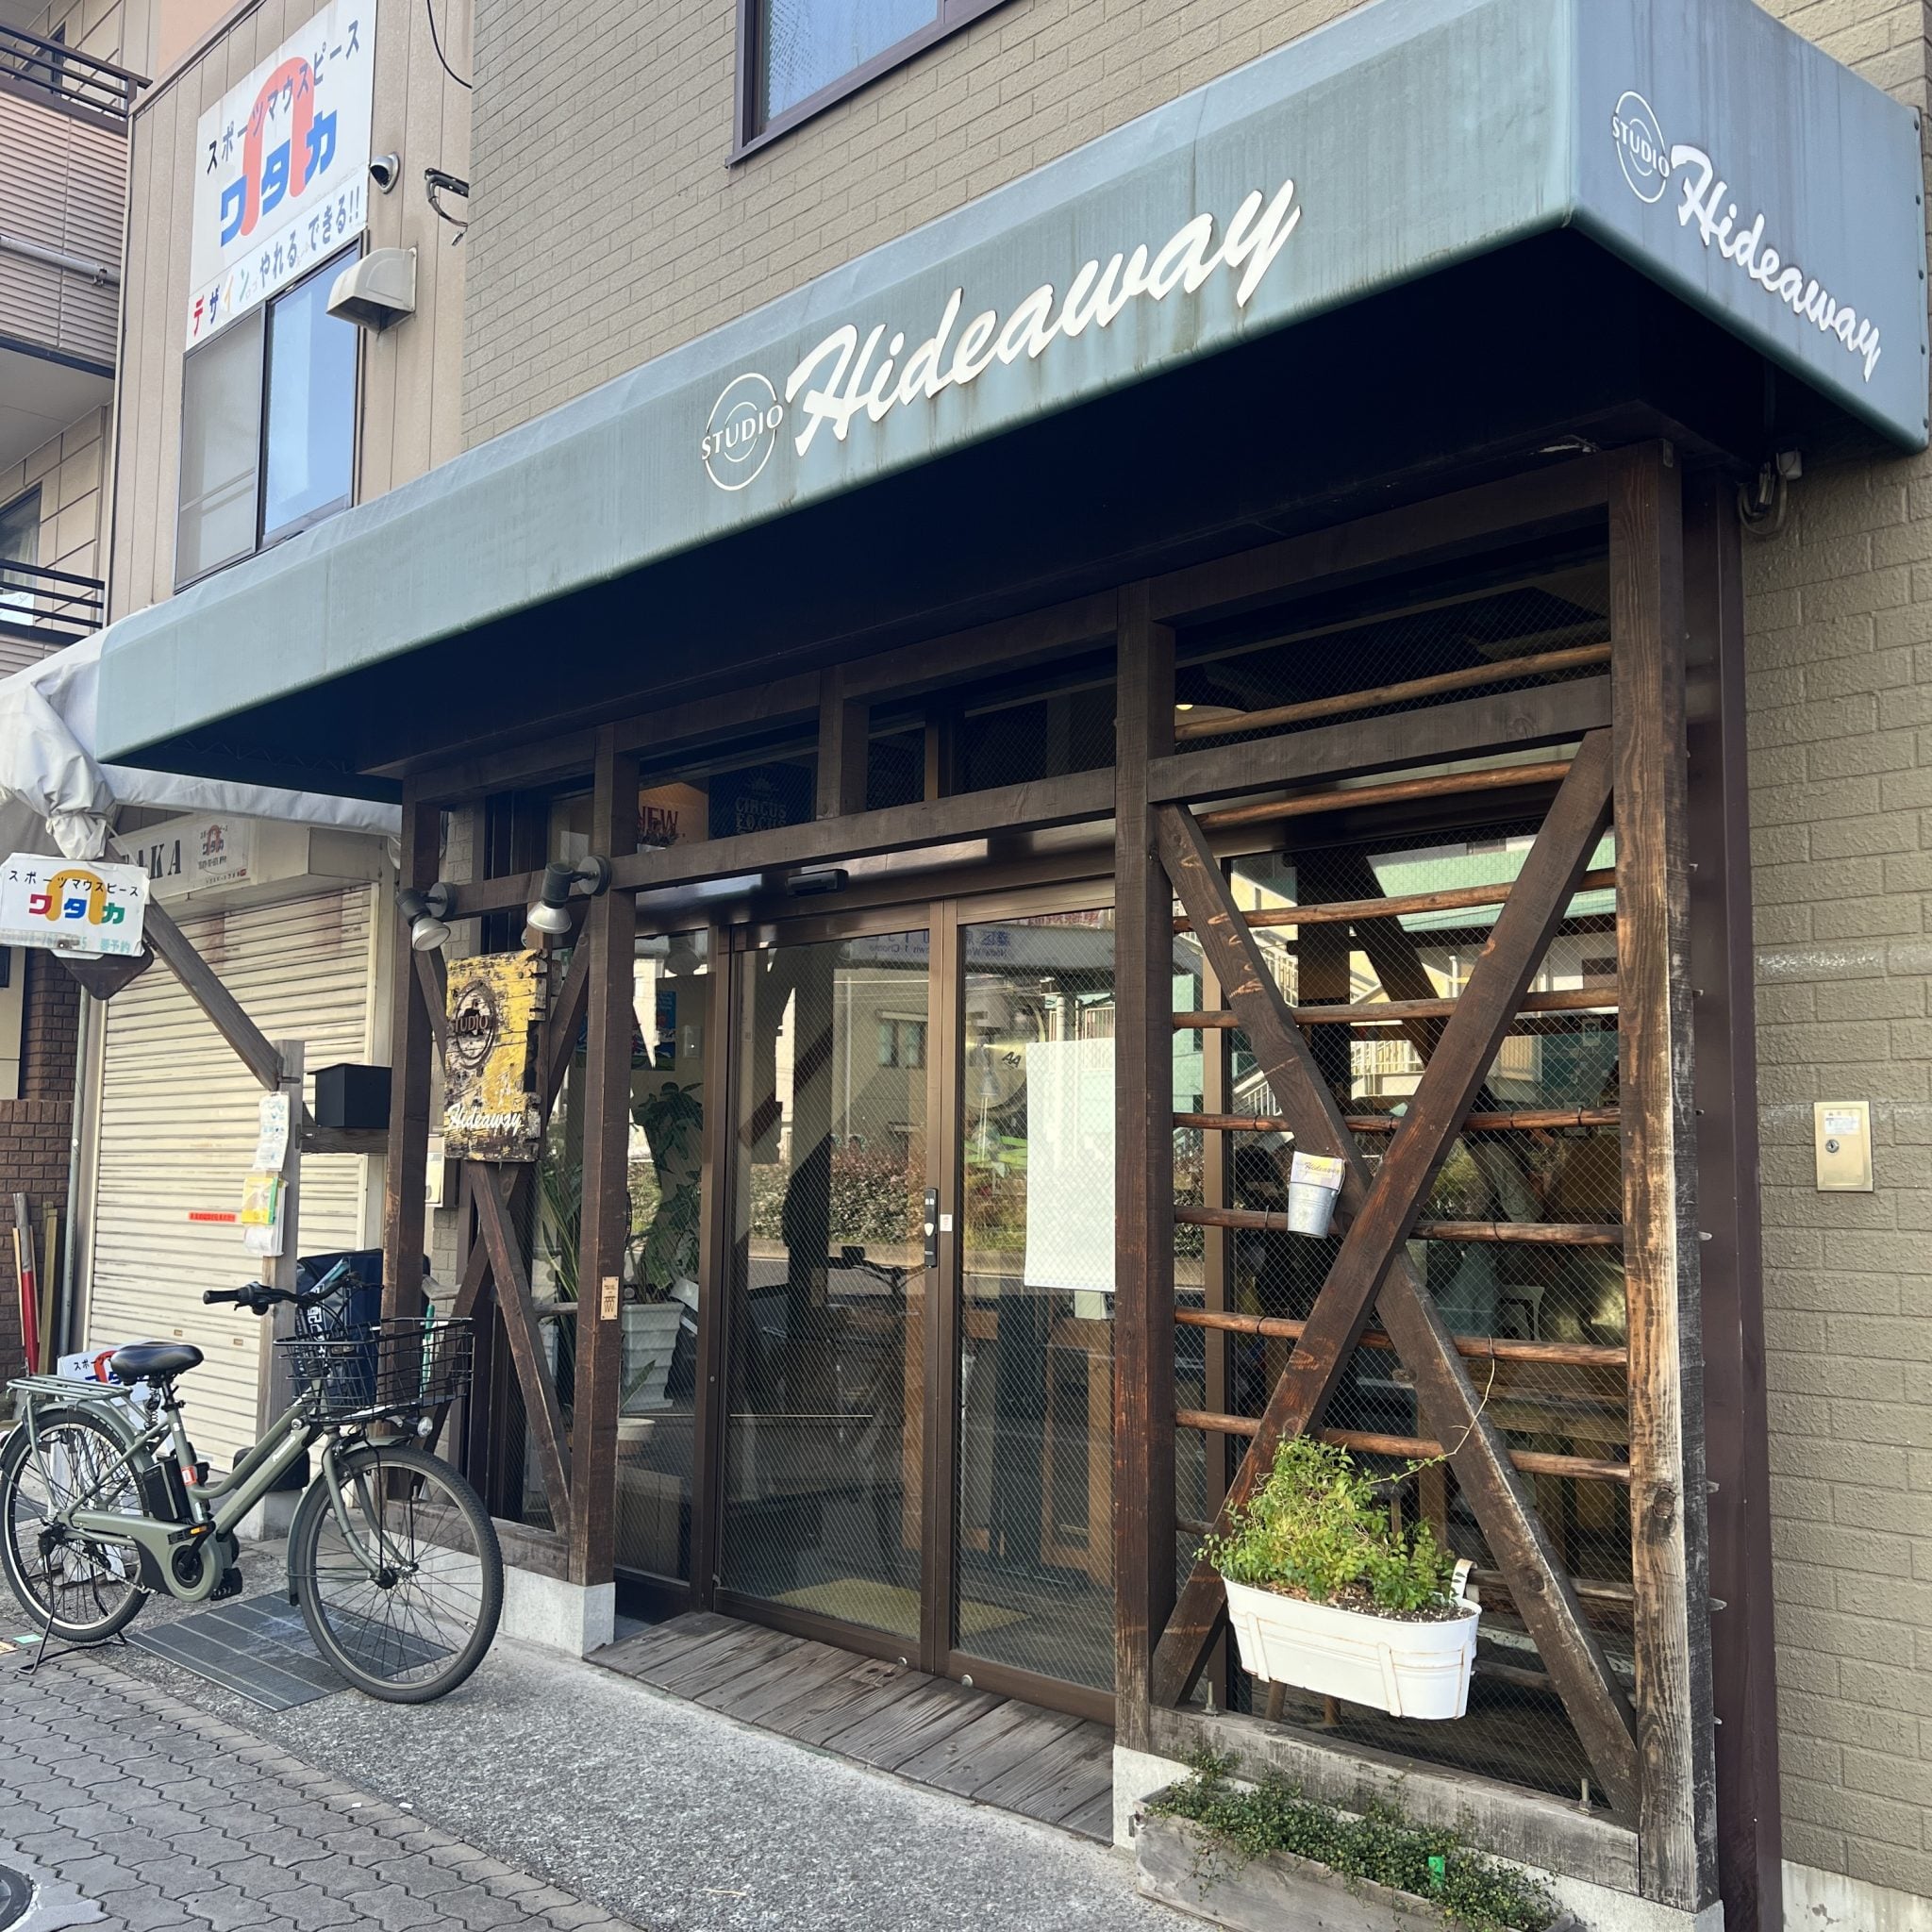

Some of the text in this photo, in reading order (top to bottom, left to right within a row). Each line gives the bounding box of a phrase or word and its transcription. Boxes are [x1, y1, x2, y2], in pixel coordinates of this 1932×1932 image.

[207, 20, 359, 175] スポーツマウスピース
[221, 109, 338, 247] ワタカ
[1612, 116, 1881, 383] STUDIO Hideaway
[701, 179, 1302, 461] STUDIO Hideaway
[29, 894, 125, 924] ワタカ
[448, 1014, 489, 1034] STUDIO
[447, 1103, 522, 1136] Hideaway
